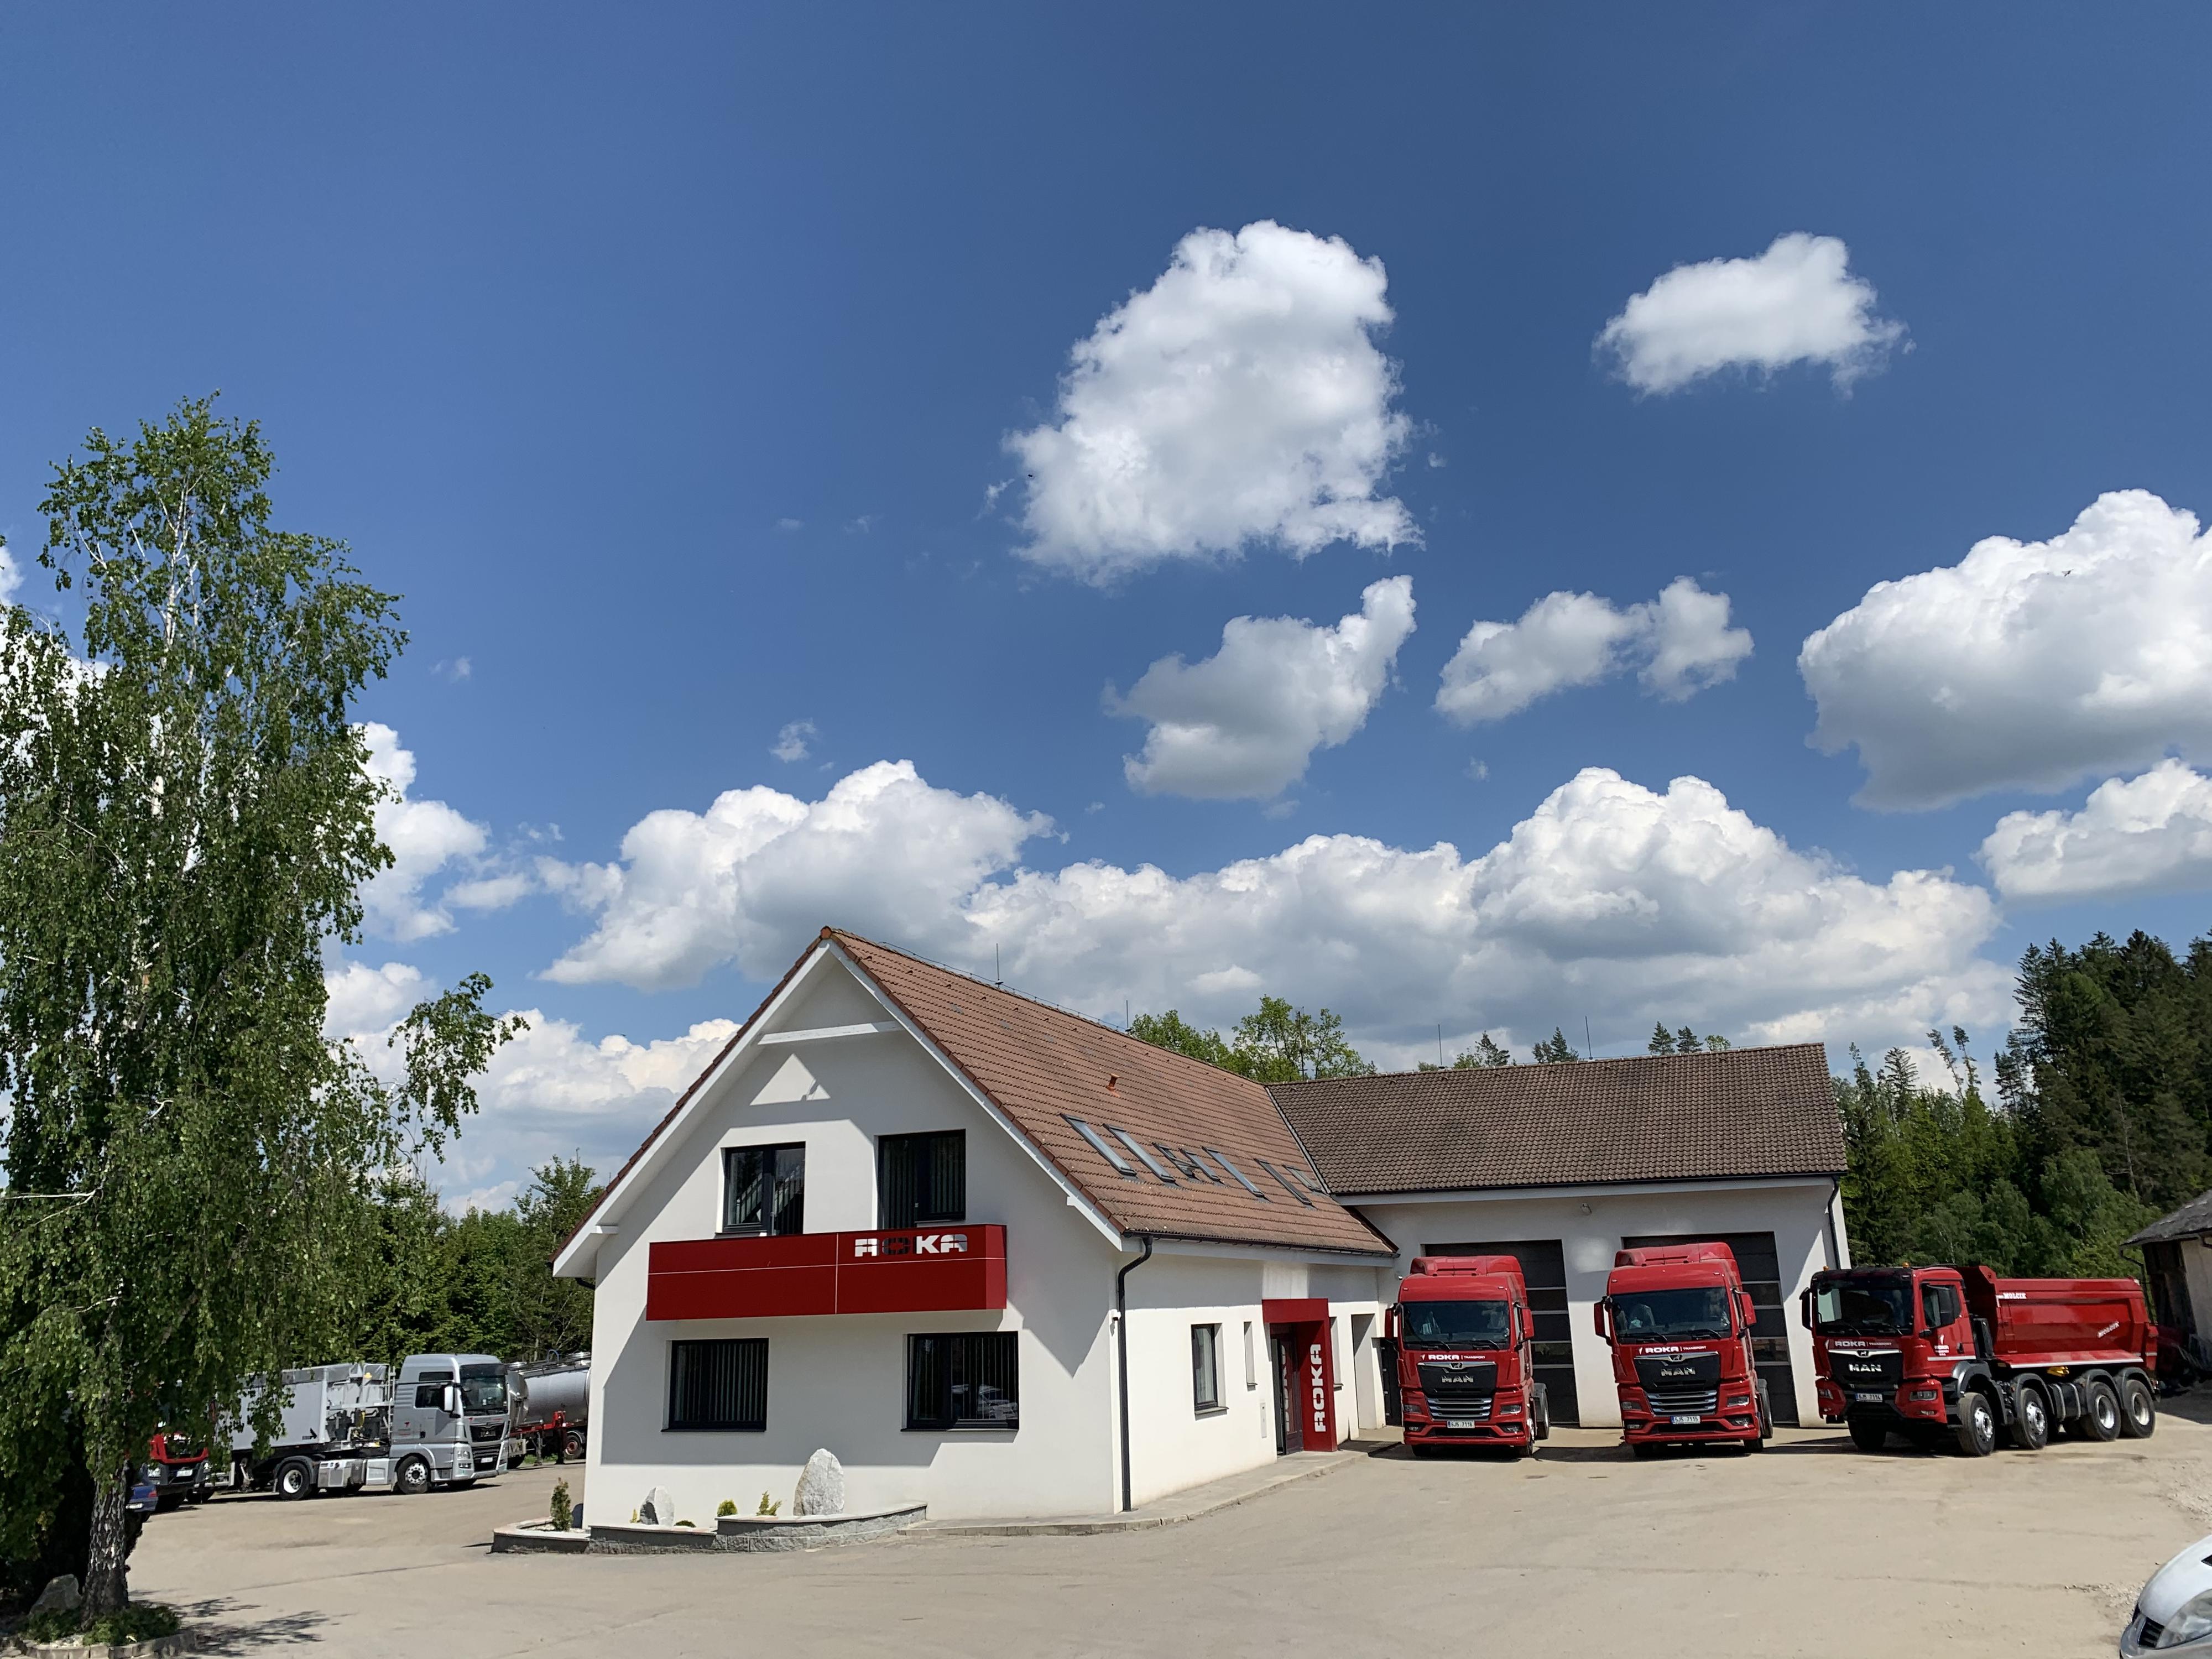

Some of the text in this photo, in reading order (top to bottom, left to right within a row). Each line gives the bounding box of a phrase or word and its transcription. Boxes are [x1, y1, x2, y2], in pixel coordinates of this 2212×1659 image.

[854, 1234, 968, 1257] ROKA
[1661, 1367, 1696, 1376] MAN
[1849, 1364, 1882, 1372] MAN
[1441, 1375, 1474, 1383] MAN
[1310, 1344, 1327, 1432] ROKA
